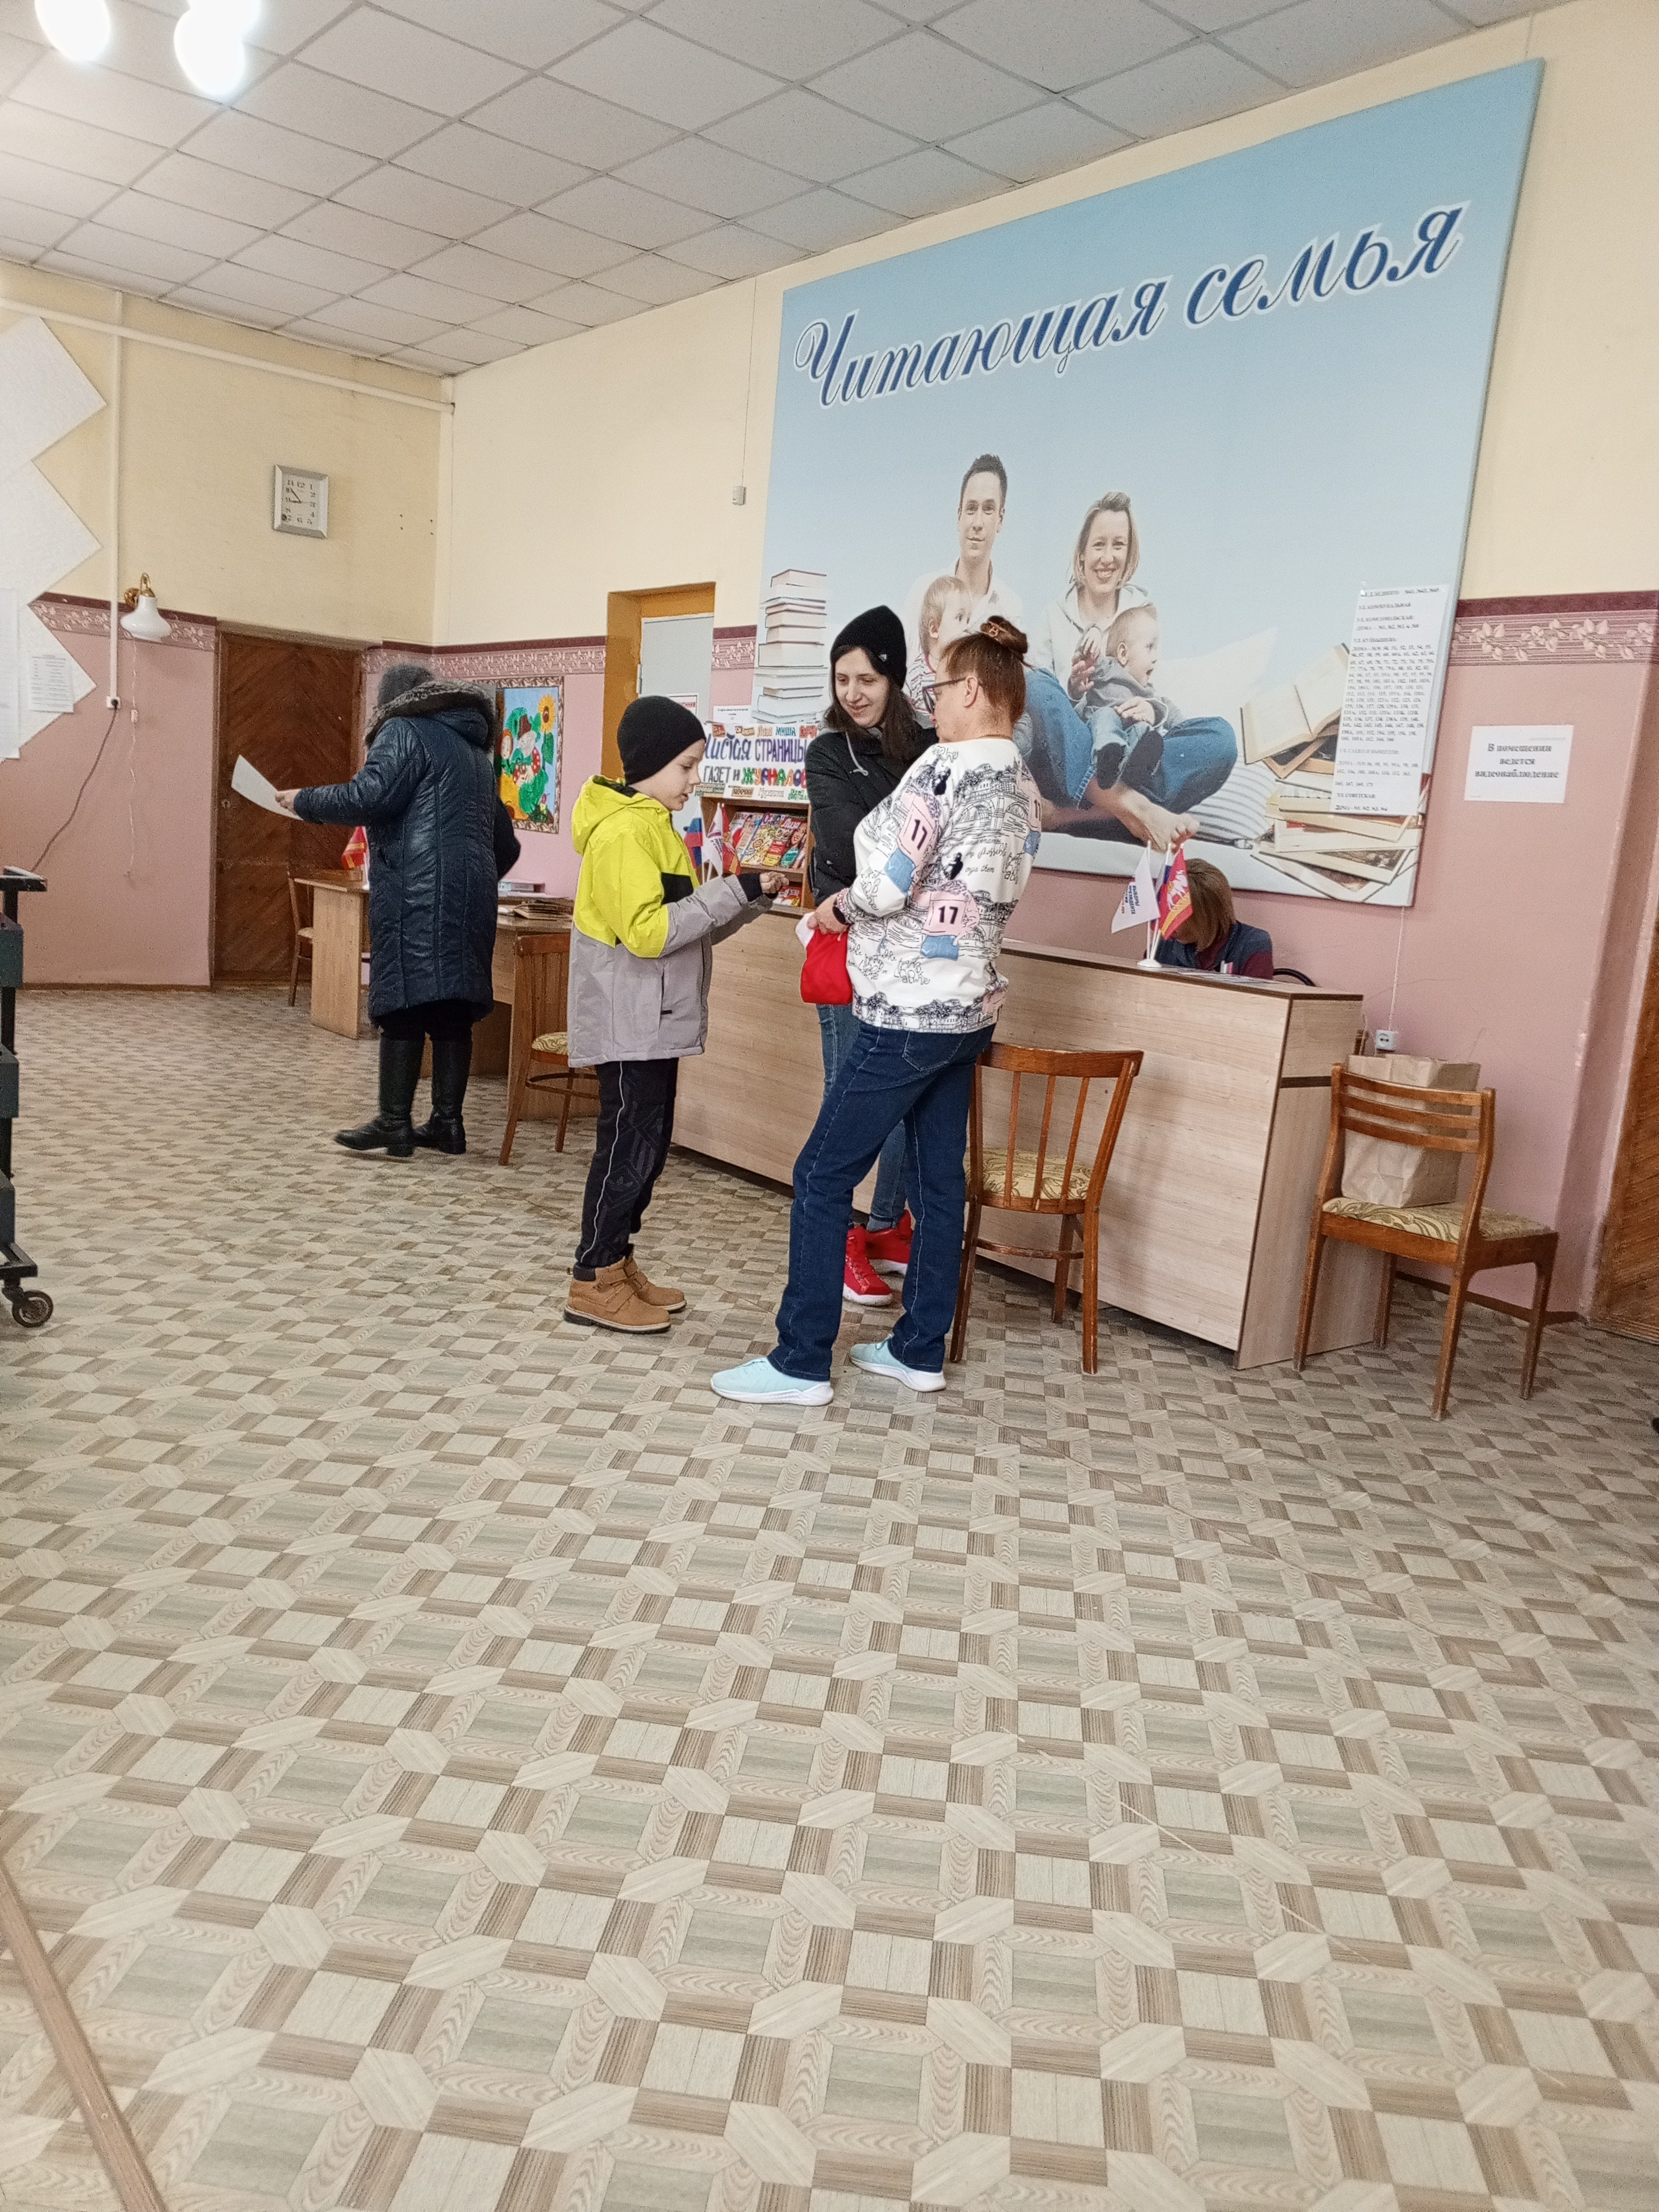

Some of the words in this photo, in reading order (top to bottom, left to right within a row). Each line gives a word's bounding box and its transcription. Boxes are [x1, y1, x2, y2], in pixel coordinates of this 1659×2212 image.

[794, 278, 1169, 407] Читающая
[1186, 206, 1464, 325] семья
[1488, 744, 1495, 752] В
[703, 765, 732, 784] ГАЗЕТ
[1474, 769, 1559, 778] видеонаблюдение
[911, 818, 929, 849] 17
[938, 905, 958, 925] 17
